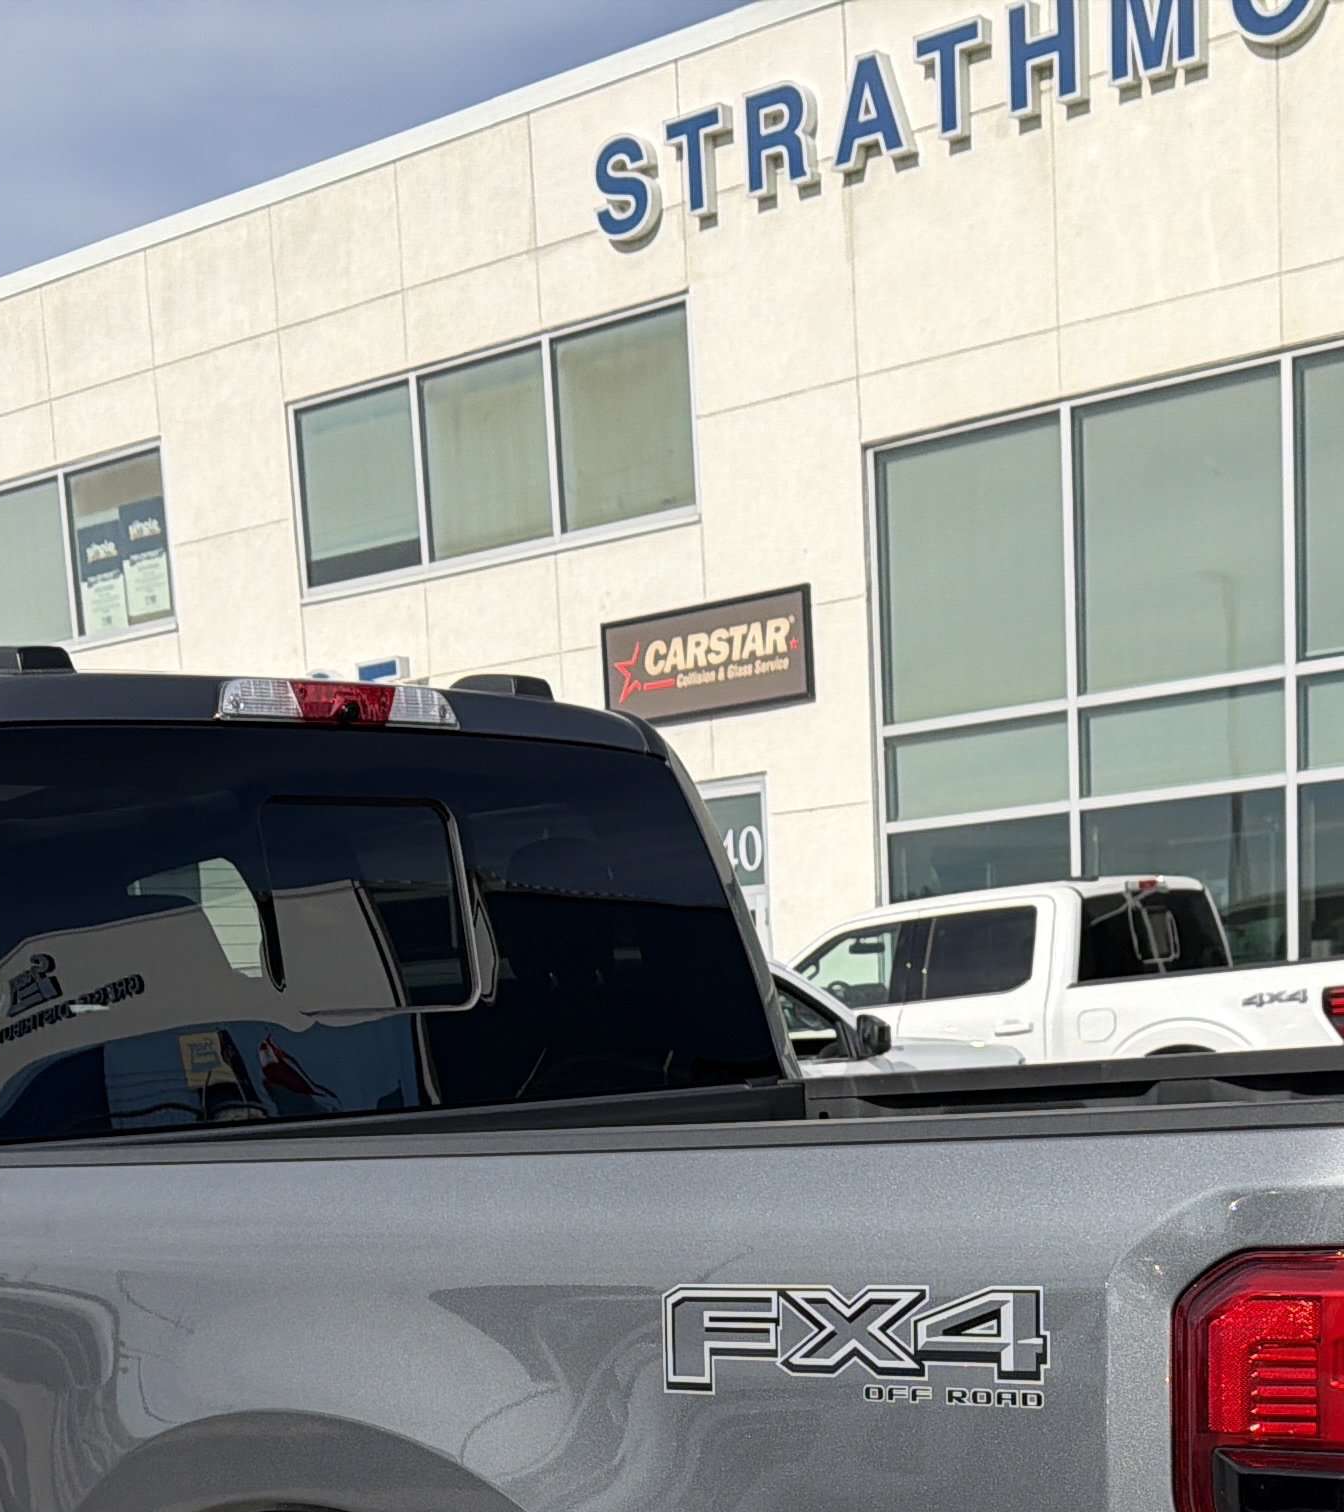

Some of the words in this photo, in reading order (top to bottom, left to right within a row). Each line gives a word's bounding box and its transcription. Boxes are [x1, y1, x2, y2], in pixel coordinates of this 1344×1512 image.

[644, 617, 792, 676] CARSTAR
[676, 666, 716, 689] Collision
[727, 661, 753, 681] Glass
[754, 655, 789, 675] Service
[663, 1284, 1051, 1394] FX4
[863, 1384, 933, 1404] OFF
[946, 1386, 1045, 1409] ROAD
